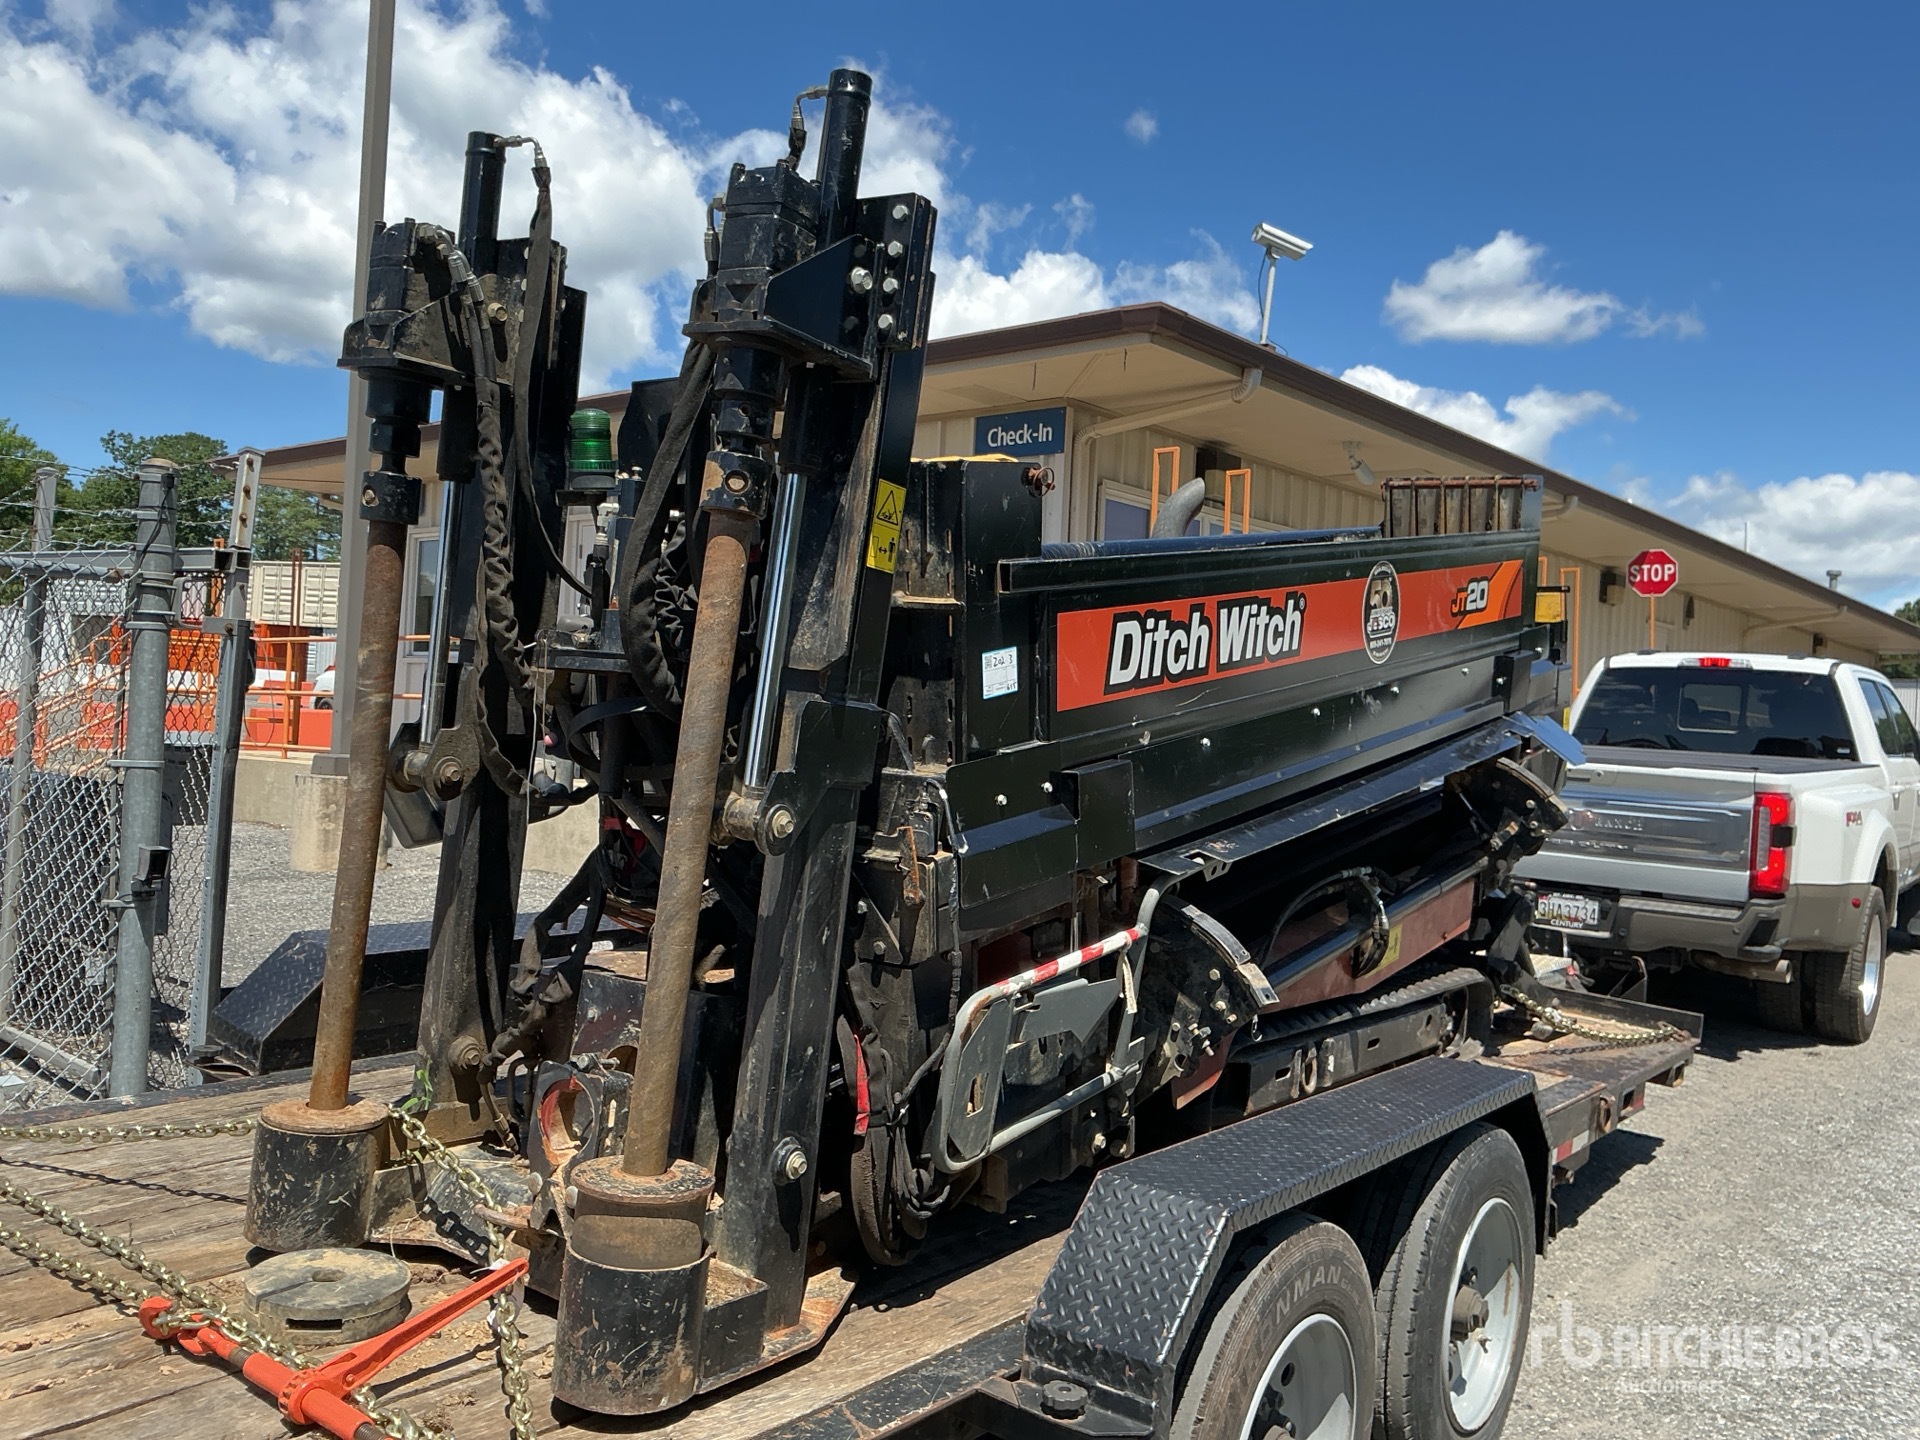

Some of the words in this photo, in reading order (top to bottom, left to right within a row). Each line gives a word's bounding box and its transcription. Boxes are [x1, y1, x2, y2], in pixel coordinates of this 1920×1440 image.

[987, 423, 1053, 448] Check-In
[1630, 564, 1675, 582] STOP
[1452, 580, 1489, 613] JT20
[1109, 611, 1210, 686] Ditch
[1219, 599, 1301, 665] Witch
[1550, 918, 1584, 928] CENTURY
